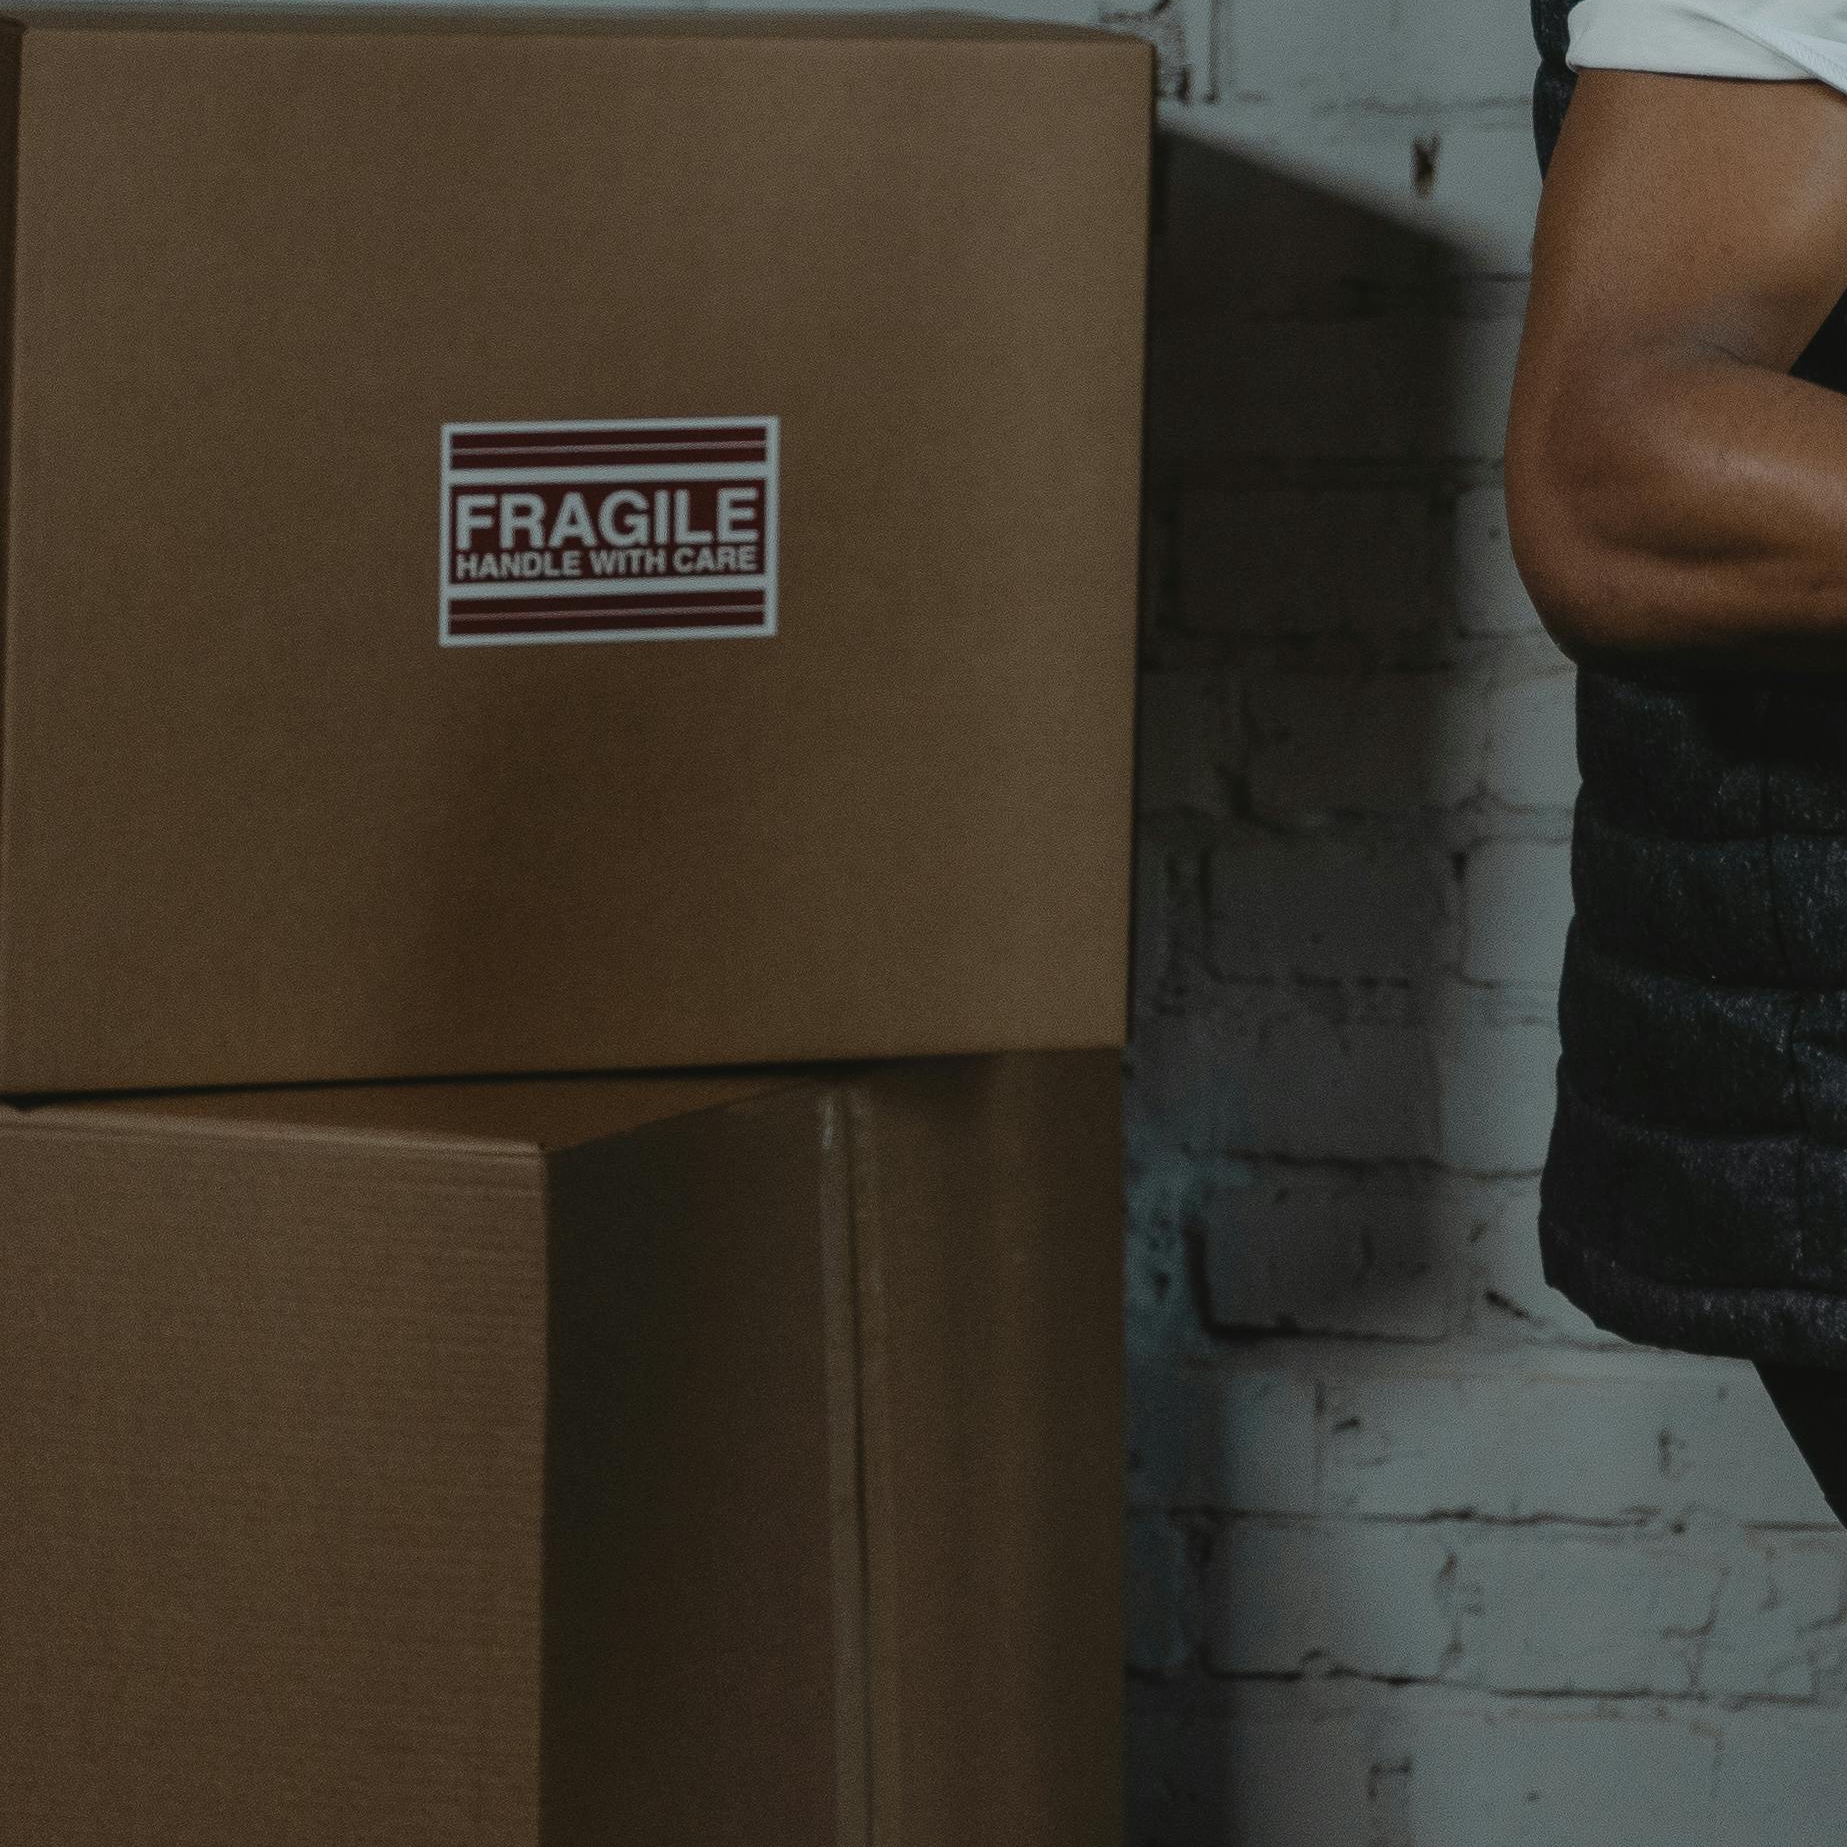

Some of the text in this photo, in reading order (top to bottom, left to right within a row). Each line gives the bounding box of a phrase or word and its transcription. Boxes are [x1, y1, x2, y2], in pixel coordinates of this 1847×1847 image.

[455, 487, 759, 551] FRAGILE
[456, 544, 757, 580] HANDLE WITH CARE
